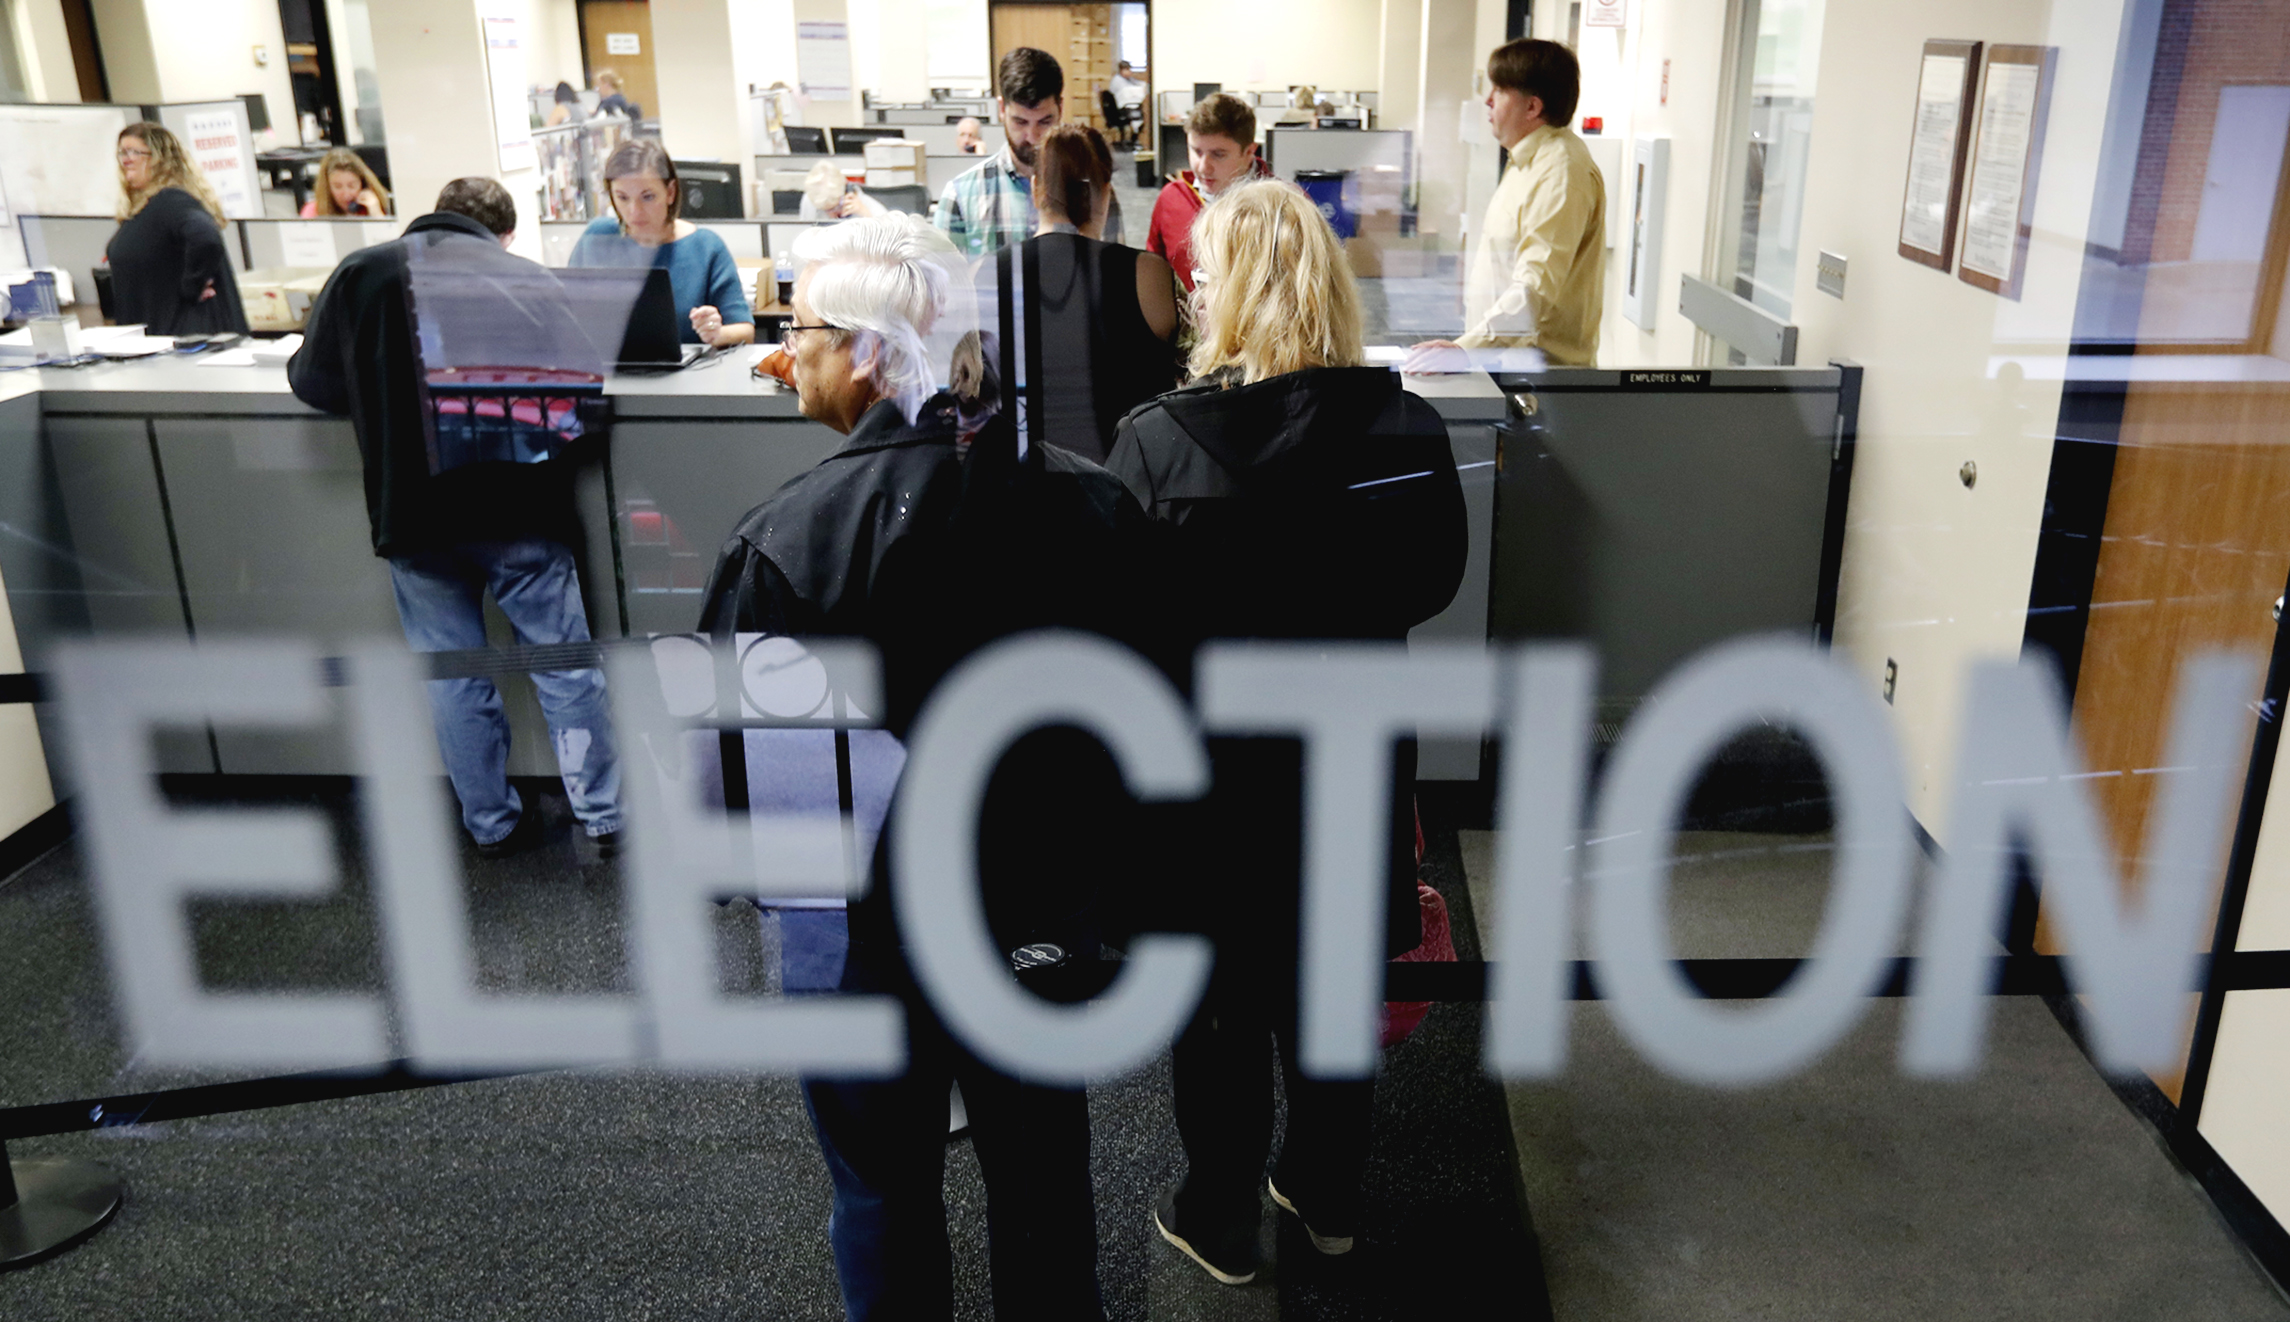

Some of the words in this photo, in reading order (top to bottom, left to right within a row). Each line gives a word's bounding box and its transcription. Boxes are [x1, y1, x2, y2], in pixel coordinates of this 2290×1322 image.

[194, 134, 238, 151] RESERVED
[201, 157, 240, 172] PARKING
[1629, 373, 1677, 383] EMPLOYEES
[1680, 373, 1701, 383] ONLY
[45, 633, 2262, 1087] ELECTION
